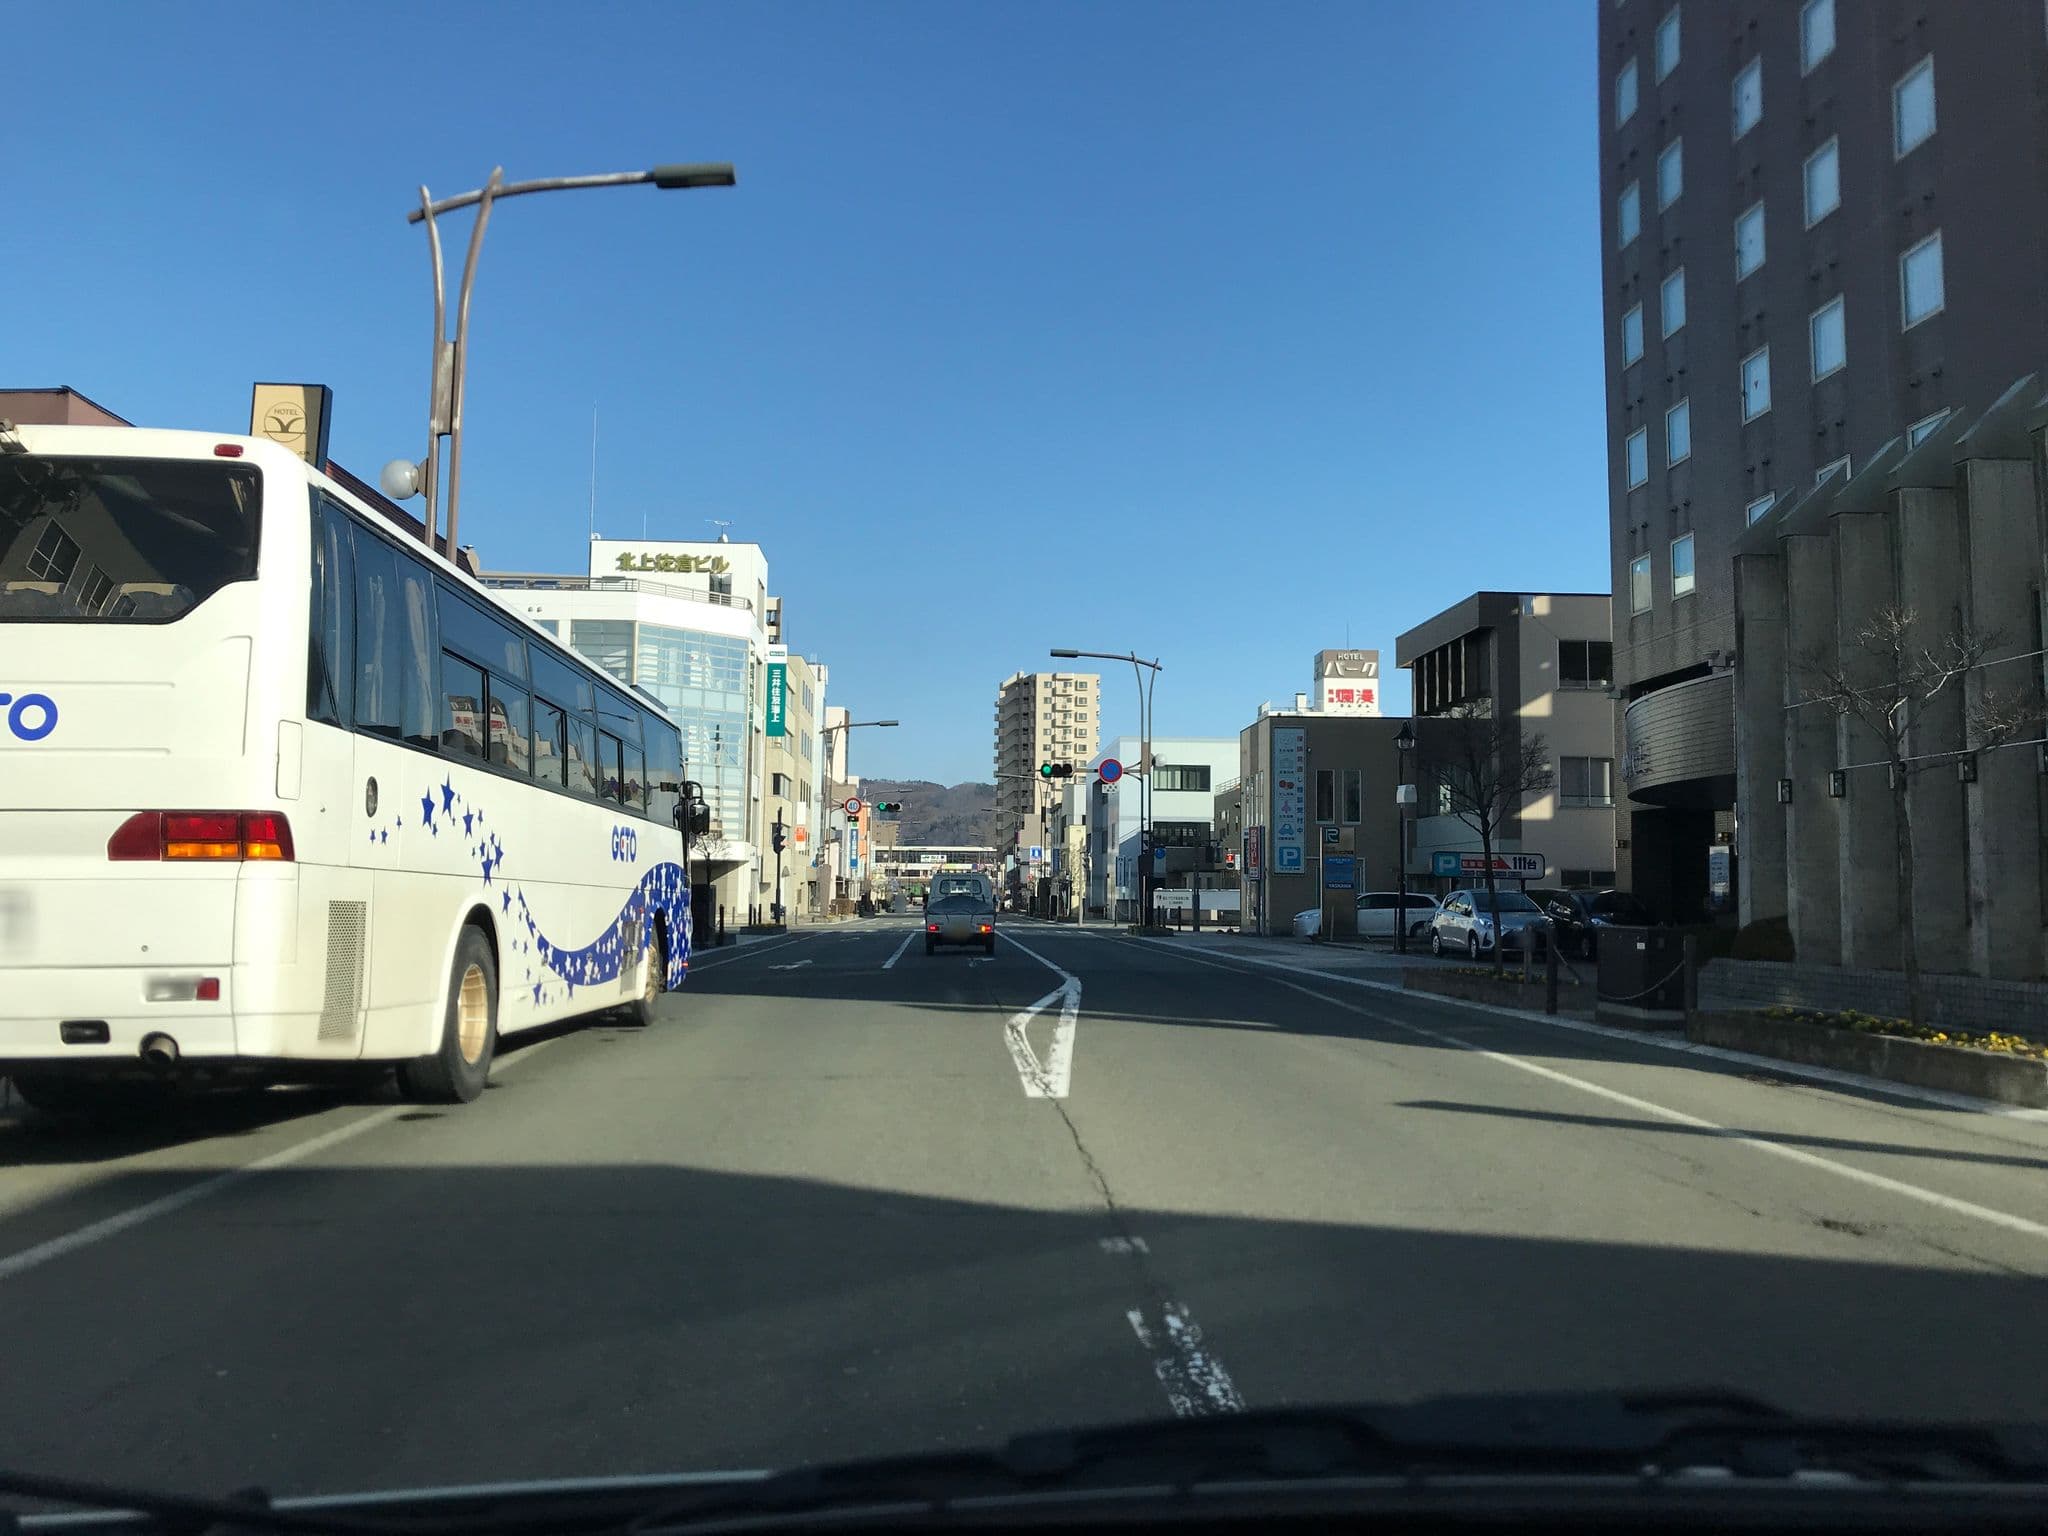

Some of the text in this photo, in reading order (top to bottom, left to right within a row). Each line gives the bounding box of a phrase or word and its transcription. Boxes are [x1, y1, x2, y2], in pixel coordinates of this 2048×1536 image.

[1324, 661, 1377, 677] パーク
[848, 801, 858, 811] 40
[612, 825, 637, 863] GETO
